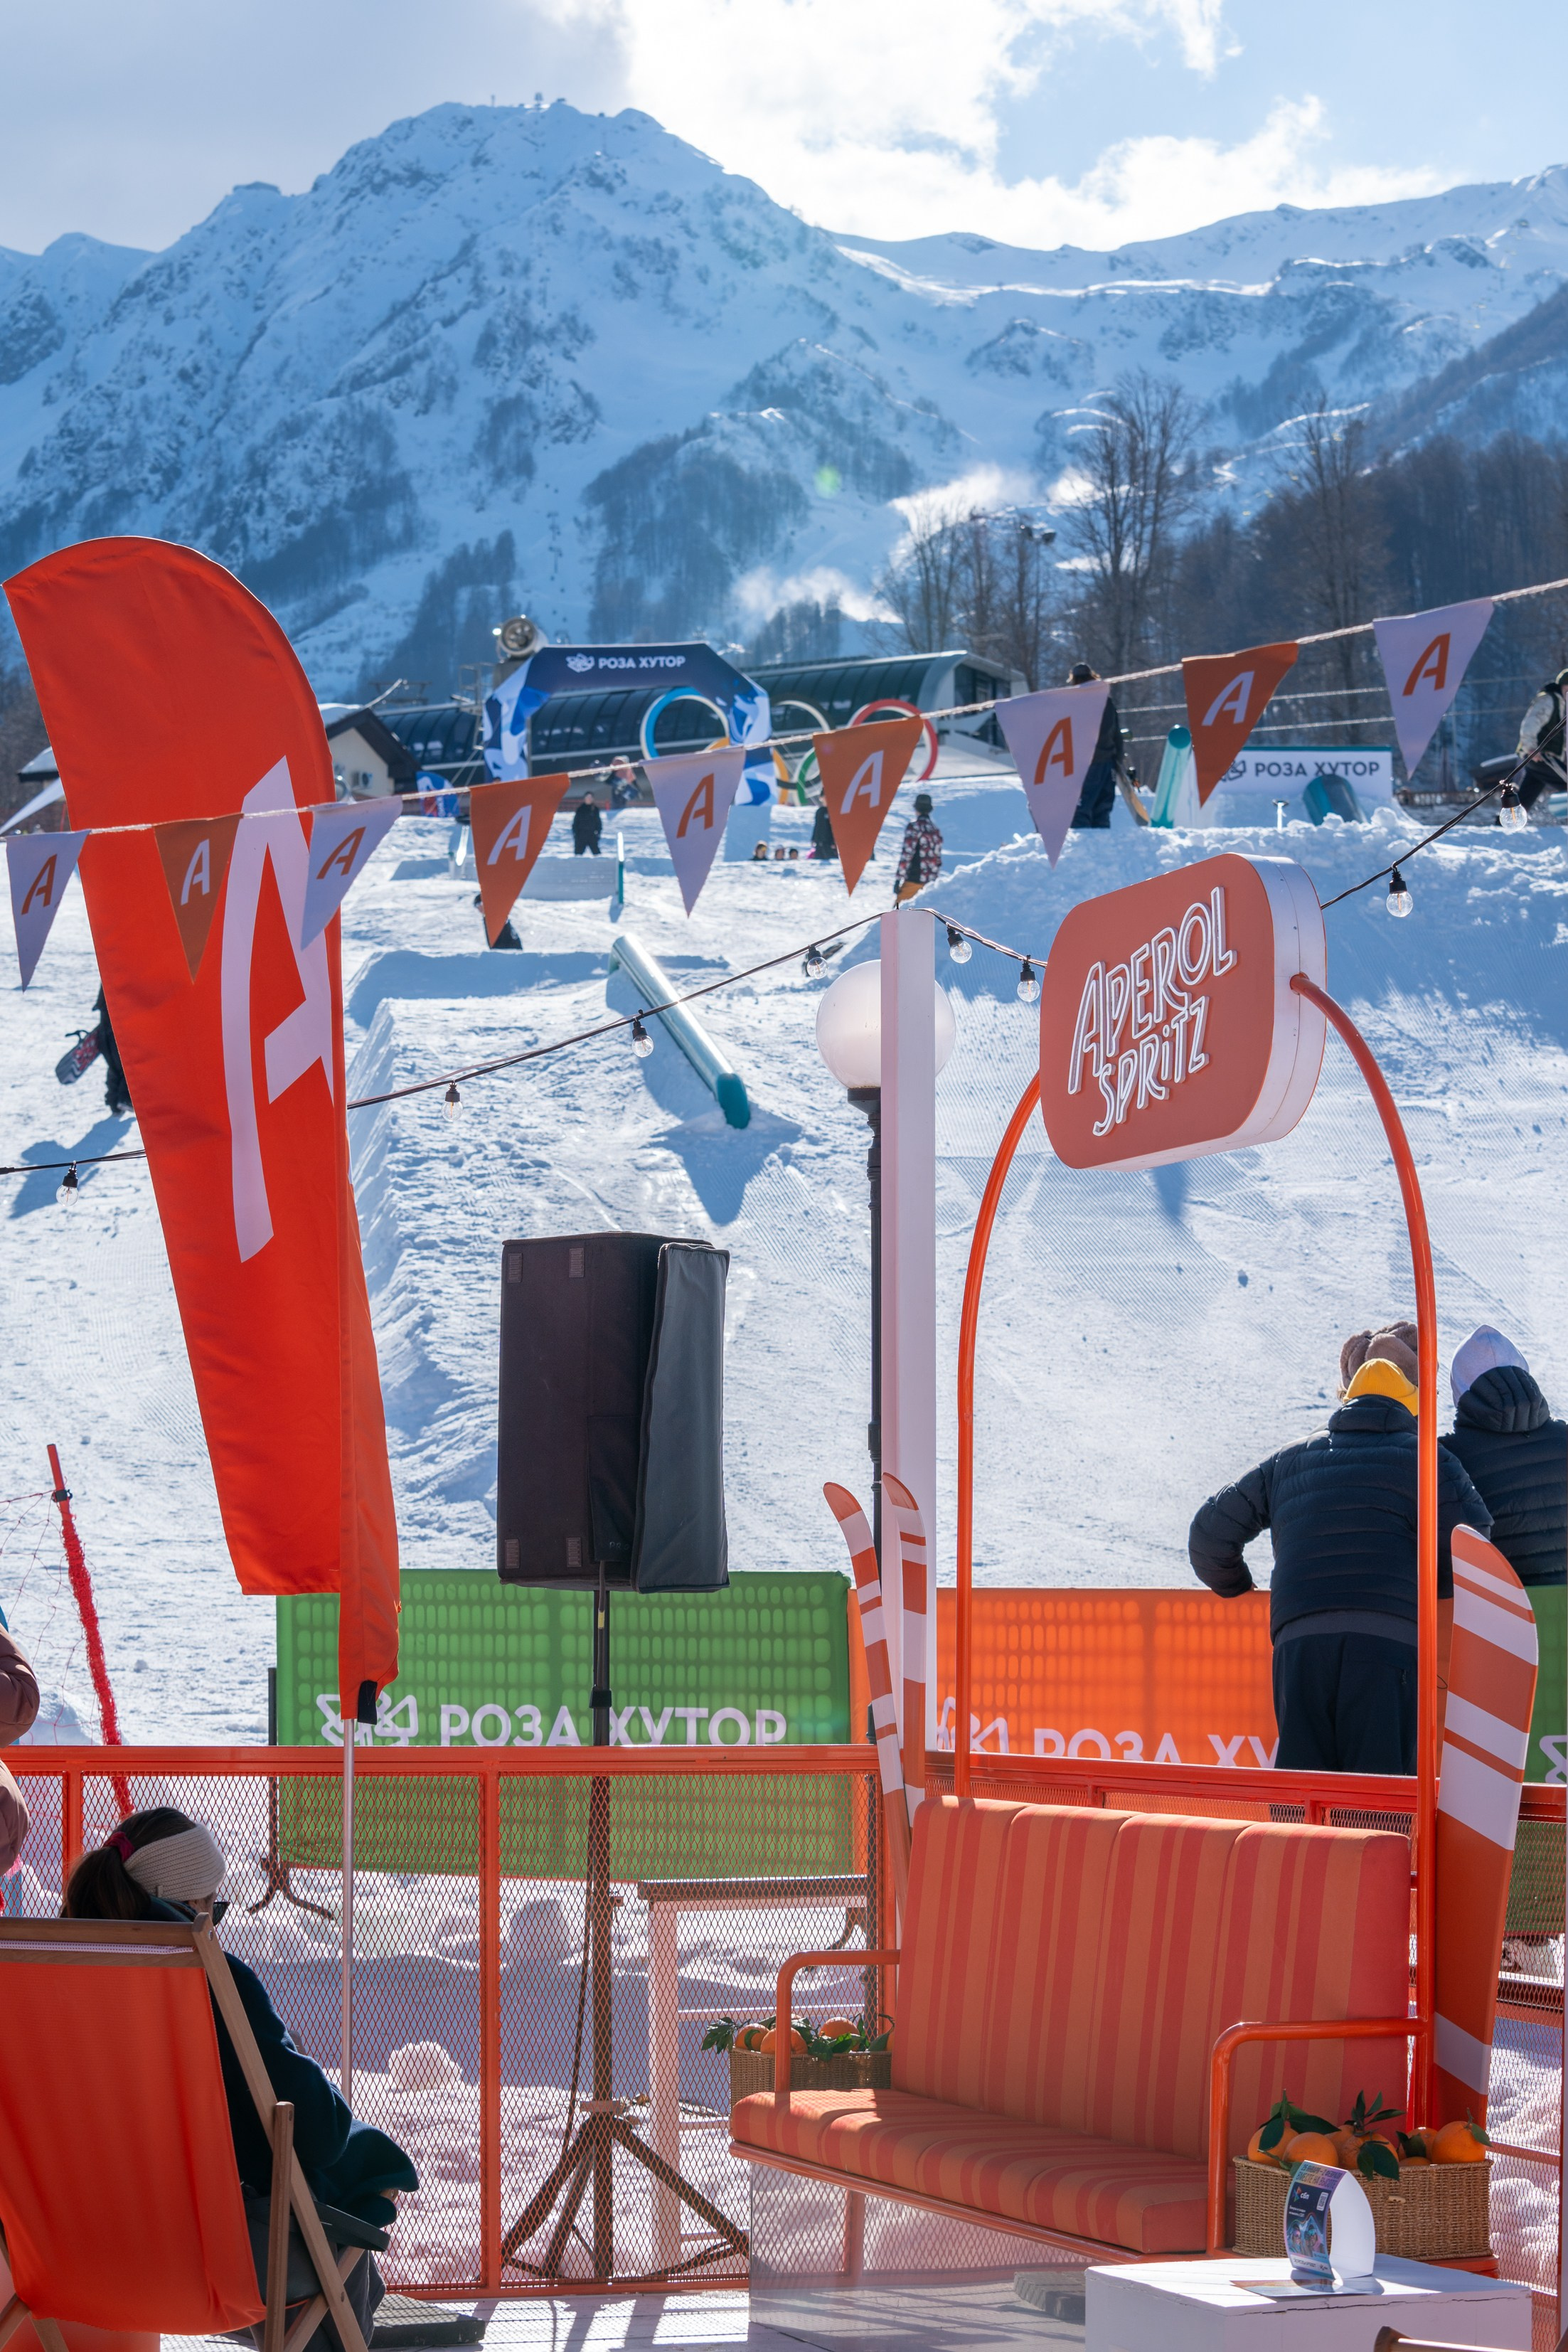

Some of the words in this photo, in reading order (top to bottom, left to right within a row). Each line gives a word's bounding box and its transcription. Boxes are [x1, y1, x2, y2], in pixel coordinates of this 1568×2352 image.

[598, 657, 636, 669] РОЗА
[639, 656, 686, 668] ХУТОР
[1402, 633, 1451, 696] A
[1201, 671, 1254, 726] A
[1034, 717, 1074, 784] A
[1254, 762, 1308, 777] РОЗА
[1314, 761, 1380, 777] ХУТОР
[676, 773, 714, 838] A
[840, 750, 884, 814] A
[316, 827, 366, 880] A
[487, 805, 532, 866] A
[21, 854, 57, 915] A
[181, 839, 210, 906] A
[221, 755, 335, 1263] A
[1067, 885, 1237, 1095] APEROL
[440, 1703, 582, 1746] РОЗА
[609, 1706, 786, 1746] ХУТОР
[1034, 1728, 1182, 1763] РОЗА
